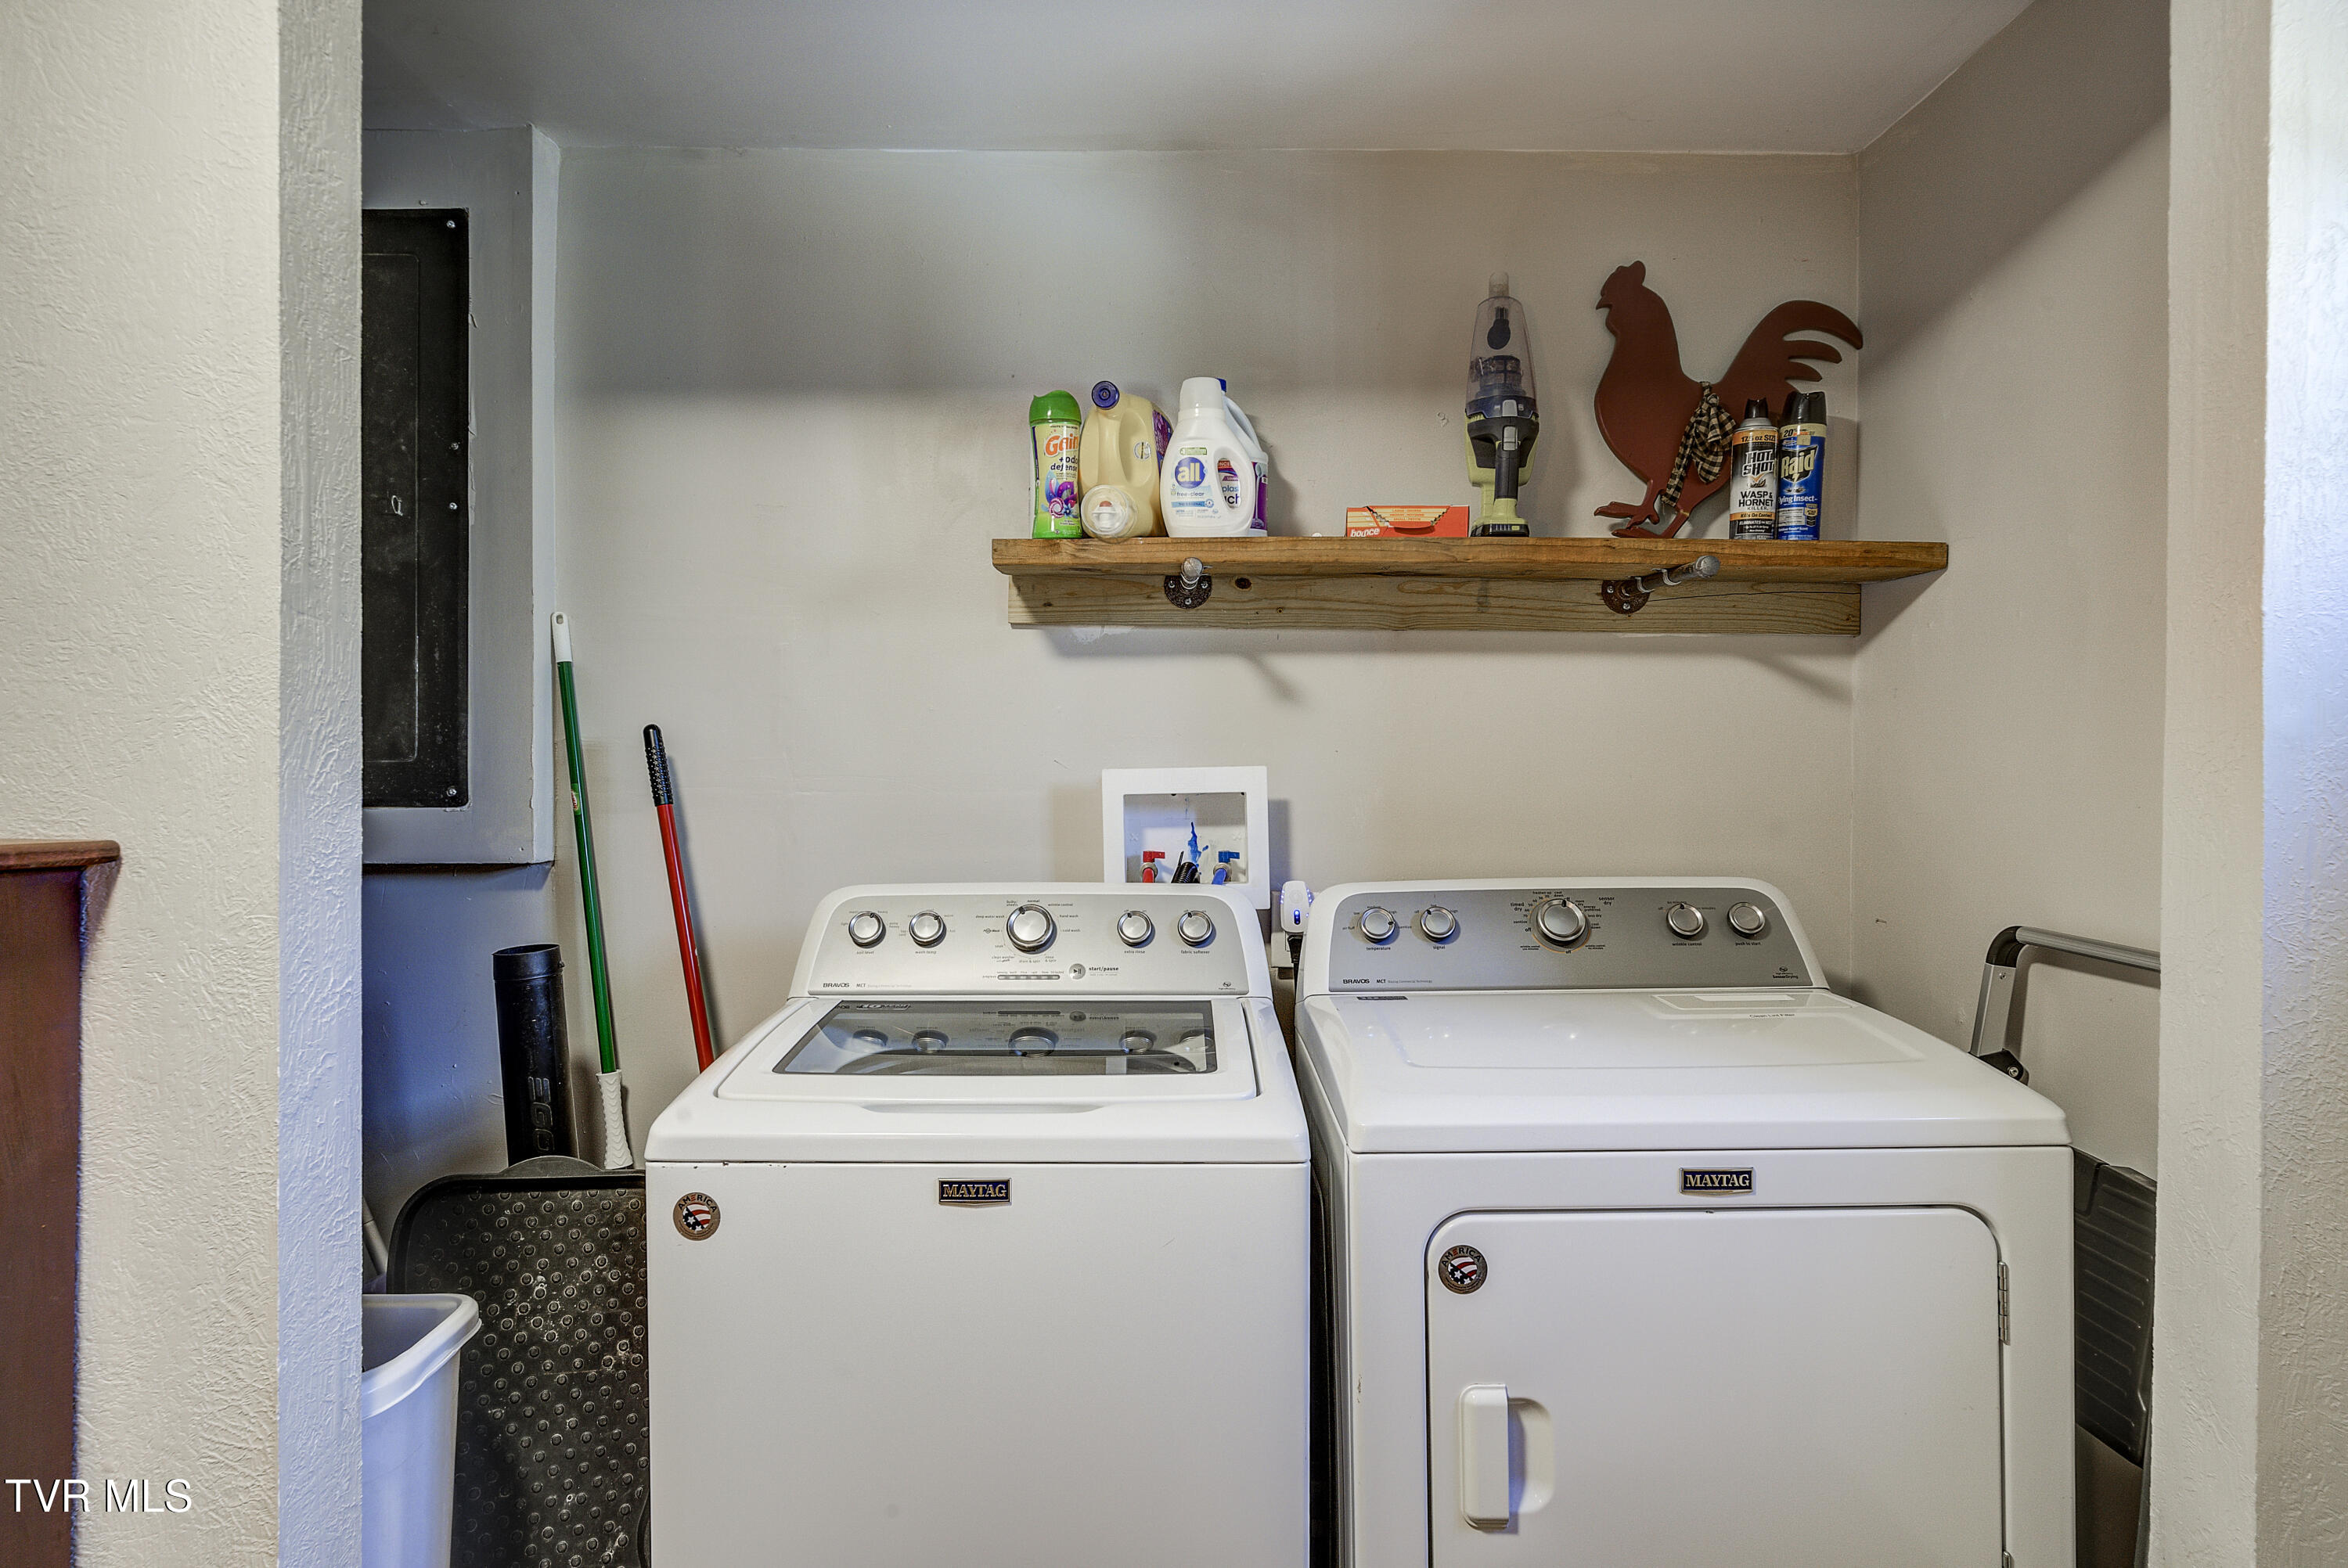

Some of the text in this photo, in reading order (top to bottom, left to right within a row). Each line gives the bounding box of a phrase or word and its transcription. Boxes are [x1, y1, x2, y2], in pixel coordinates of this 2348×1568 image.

[1784, 429, 1793, 437] 20
[1046, 433, 1079, 456] Gain
[1745, 449, 1774, 464] HOT
[1781, 449, 1815, 478] Raid
[1178, 462, 1201, 482] all
[1742, 461, 1775, 477] SHOT
[1351, 527, 1380, 537] bounce
[1685, 1174, 1750, 1187] MAYTAG
[942, 1184, 1007, 1197] MAYTAG
[679, 1194, 718, 1214] AMERICA
[1442, 1247, 1481, 1268] AMERICA
